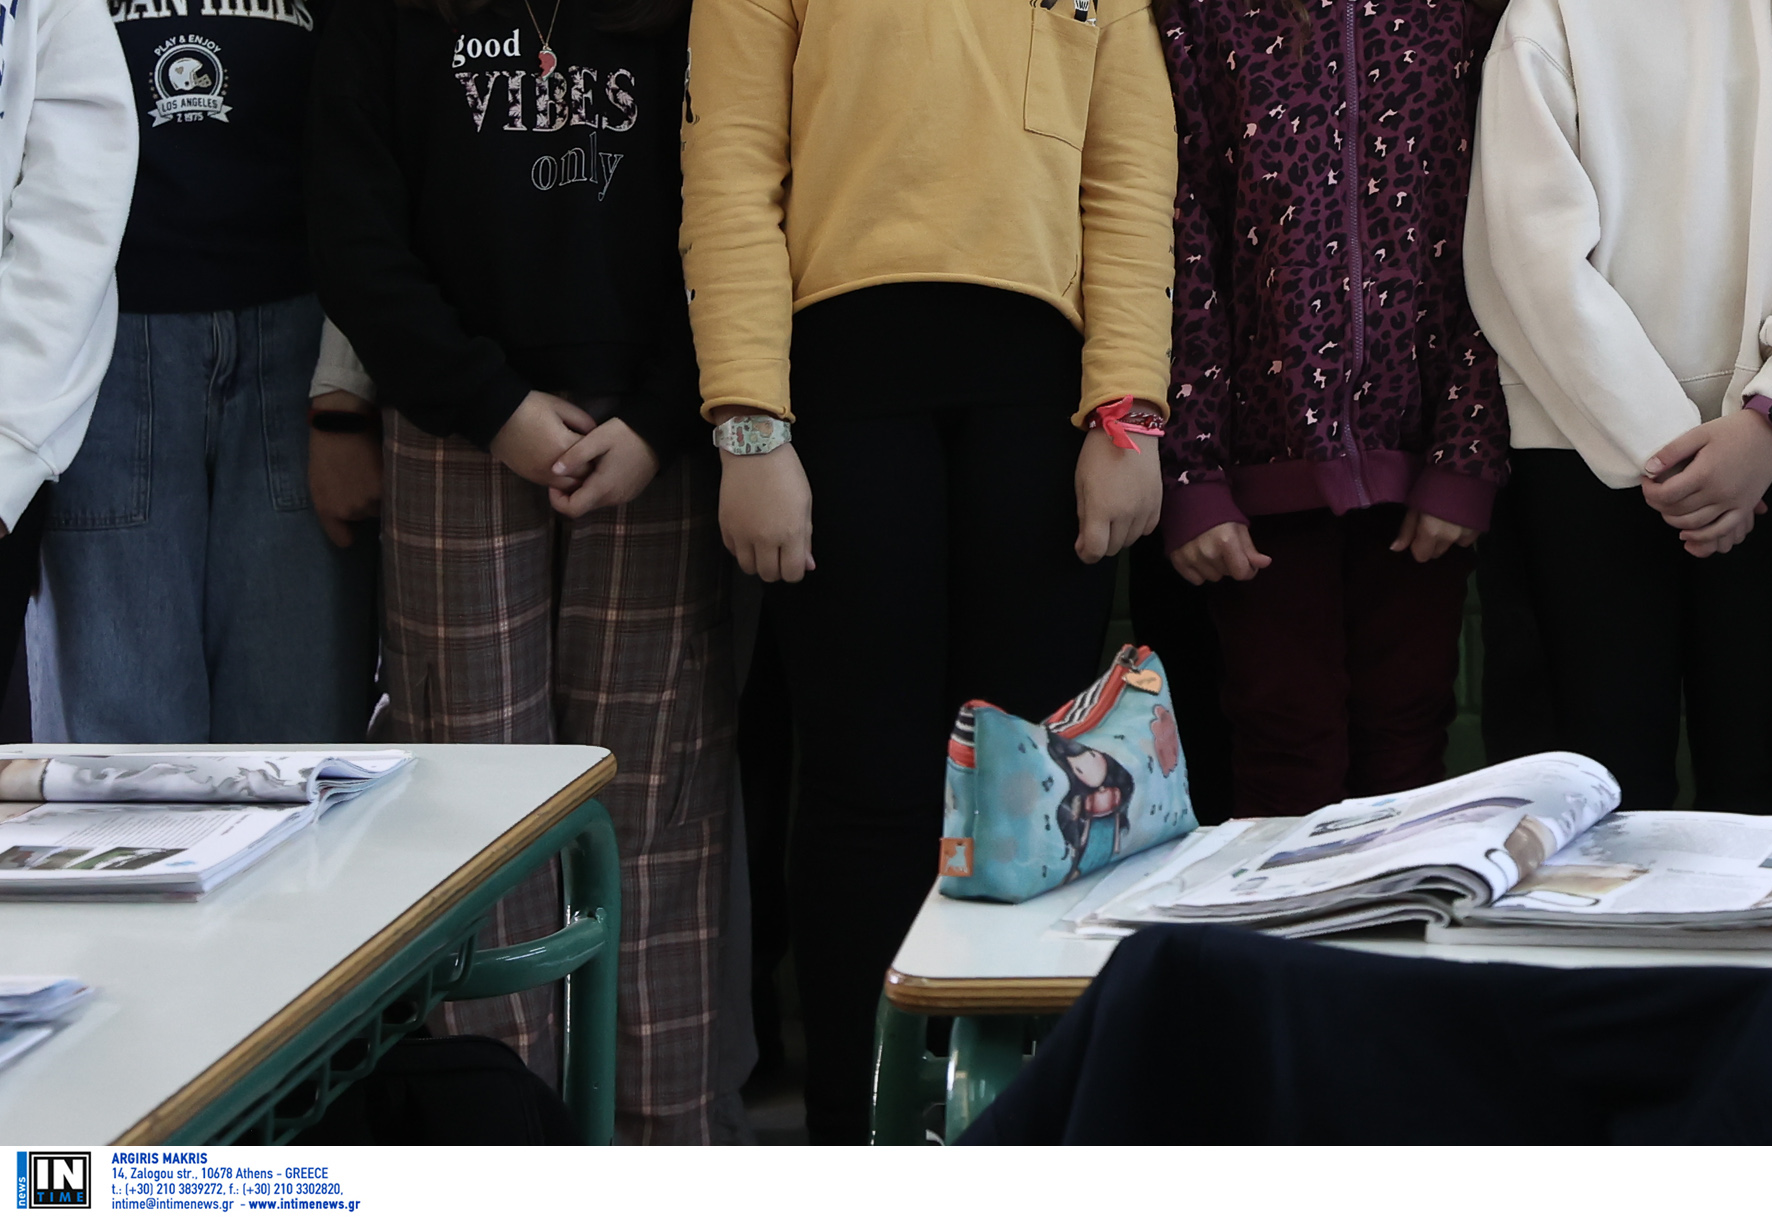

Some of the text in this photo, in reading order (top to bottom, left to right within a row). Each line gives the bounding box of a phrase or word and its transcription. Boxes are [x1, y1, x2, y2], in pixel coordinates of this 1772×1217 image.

[153, 34, 222, 57] PLAY & ENJOY
[451, 28, 522, 68] good
[161, 97, 218, 113] LOS ANGELES
[454, 65, 638, 132] VIBES
[530, 131, 624, 202] only
